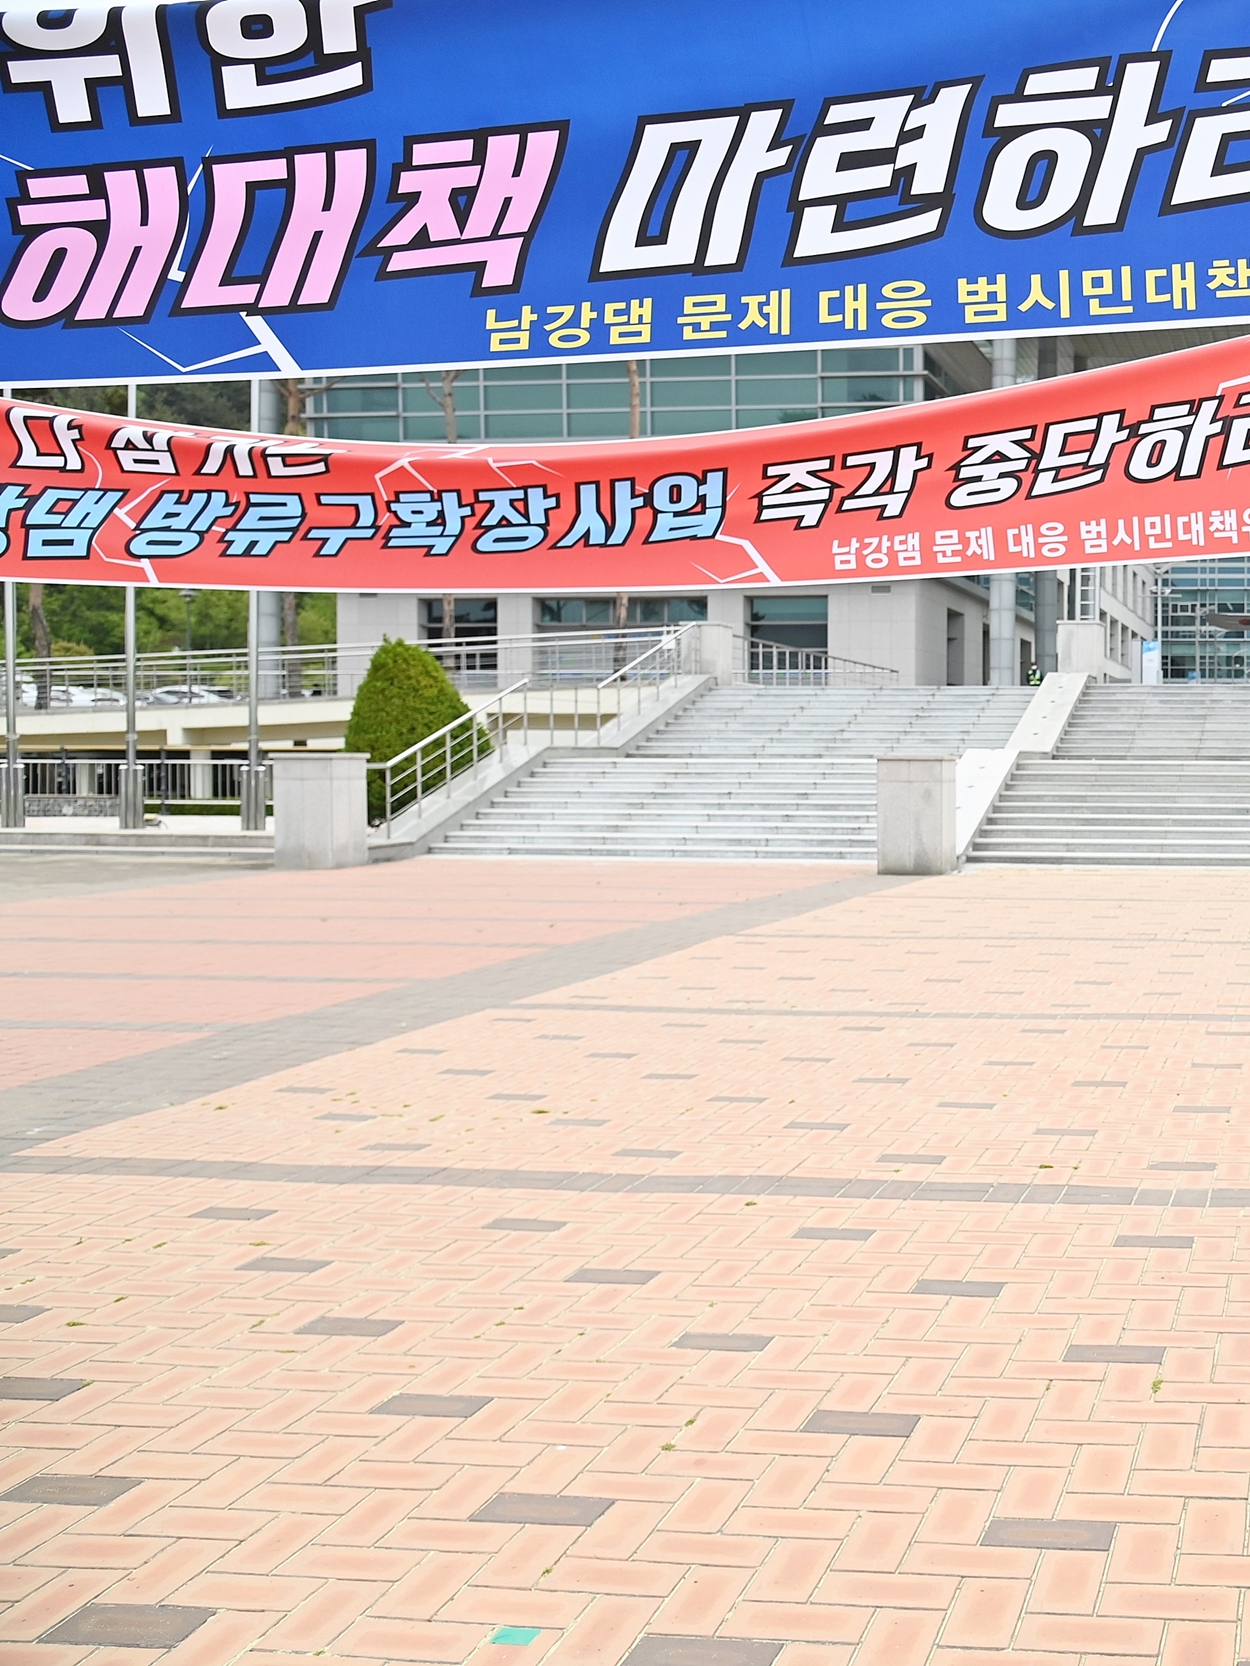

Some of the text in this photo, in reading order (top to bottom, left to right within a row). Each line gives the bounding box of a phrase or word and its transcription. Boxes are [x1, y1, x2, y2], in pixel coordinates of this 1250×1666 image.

[0, 121, 569, 327] 해대책
[485, 297, 653, 352] 남강댐
[677, 289, 791, 340] 문제
[818, 280, 932, 331] 대응
[754, 441, 932, 531] 즉각
[831, 534, 921, 570] 남강댐
[932, 526, 996, 562] 문제
[1007, 521, 1068, 558] 대응
